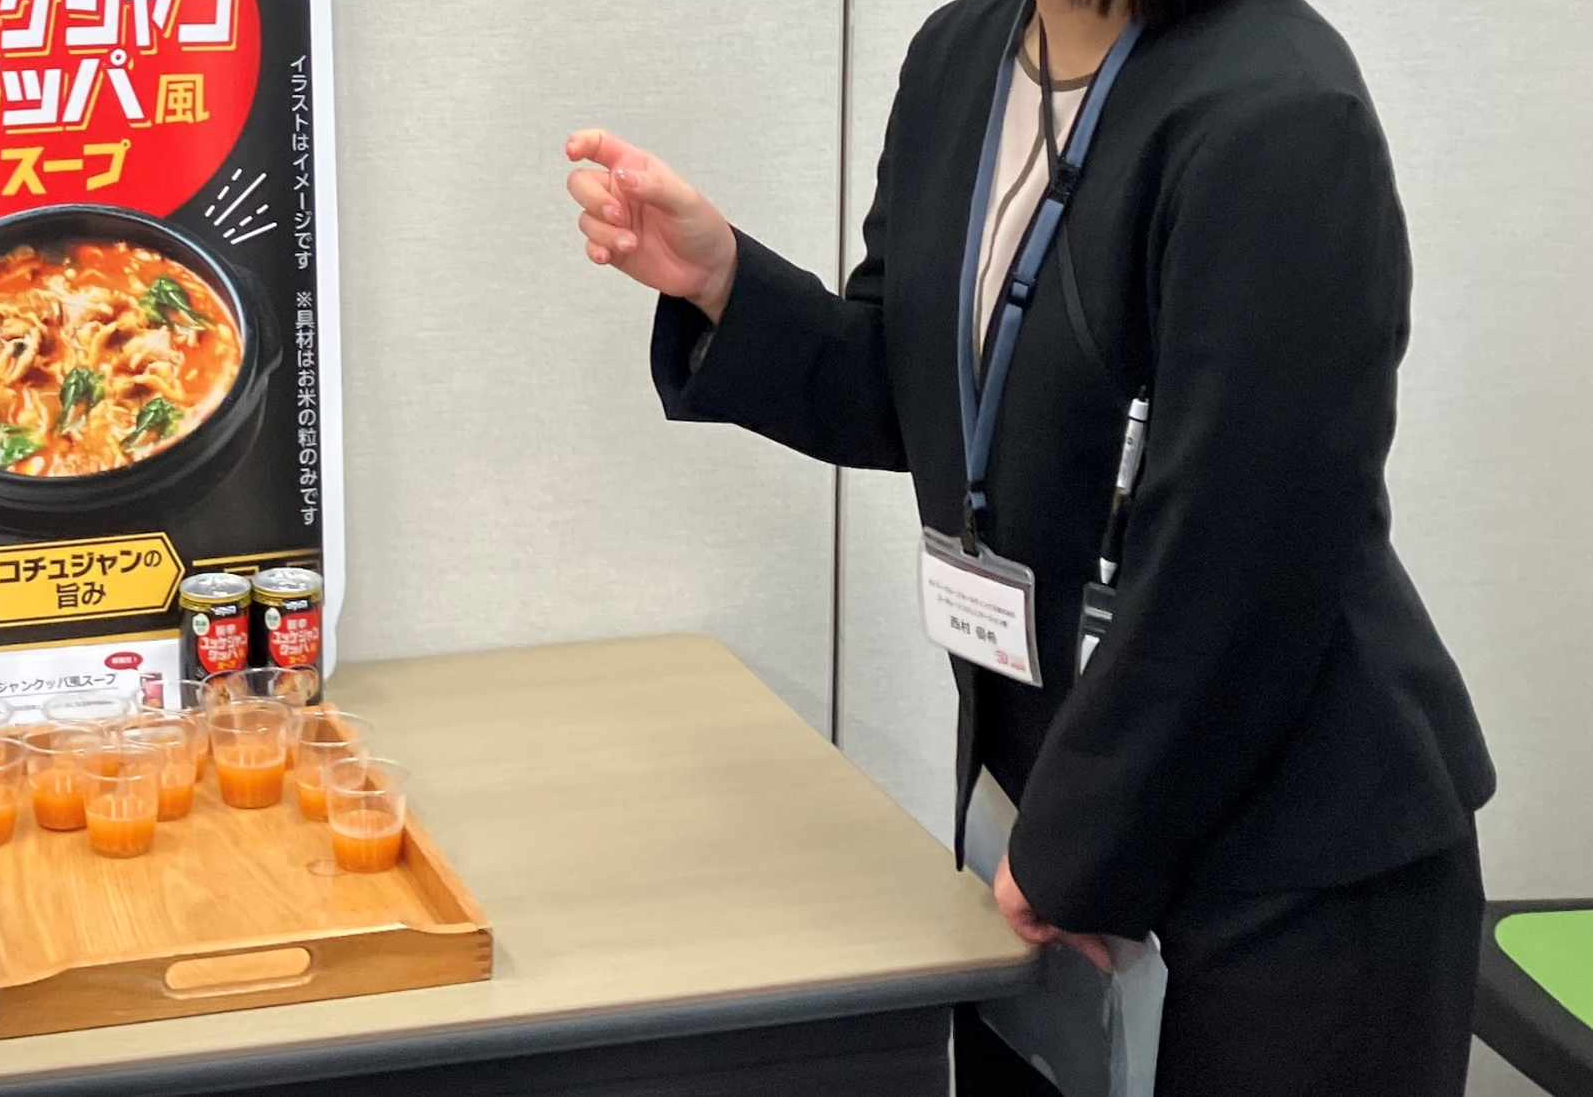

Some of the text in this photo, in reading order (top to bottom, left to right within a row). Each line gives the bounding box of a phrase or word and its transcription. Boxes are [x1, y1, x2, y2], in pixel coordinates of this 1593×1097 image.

[0, 138, 131, 196] スープ
[290, 55, 313, 270] イラストはイメージです
[56, 581, 106, 610] 旨み
